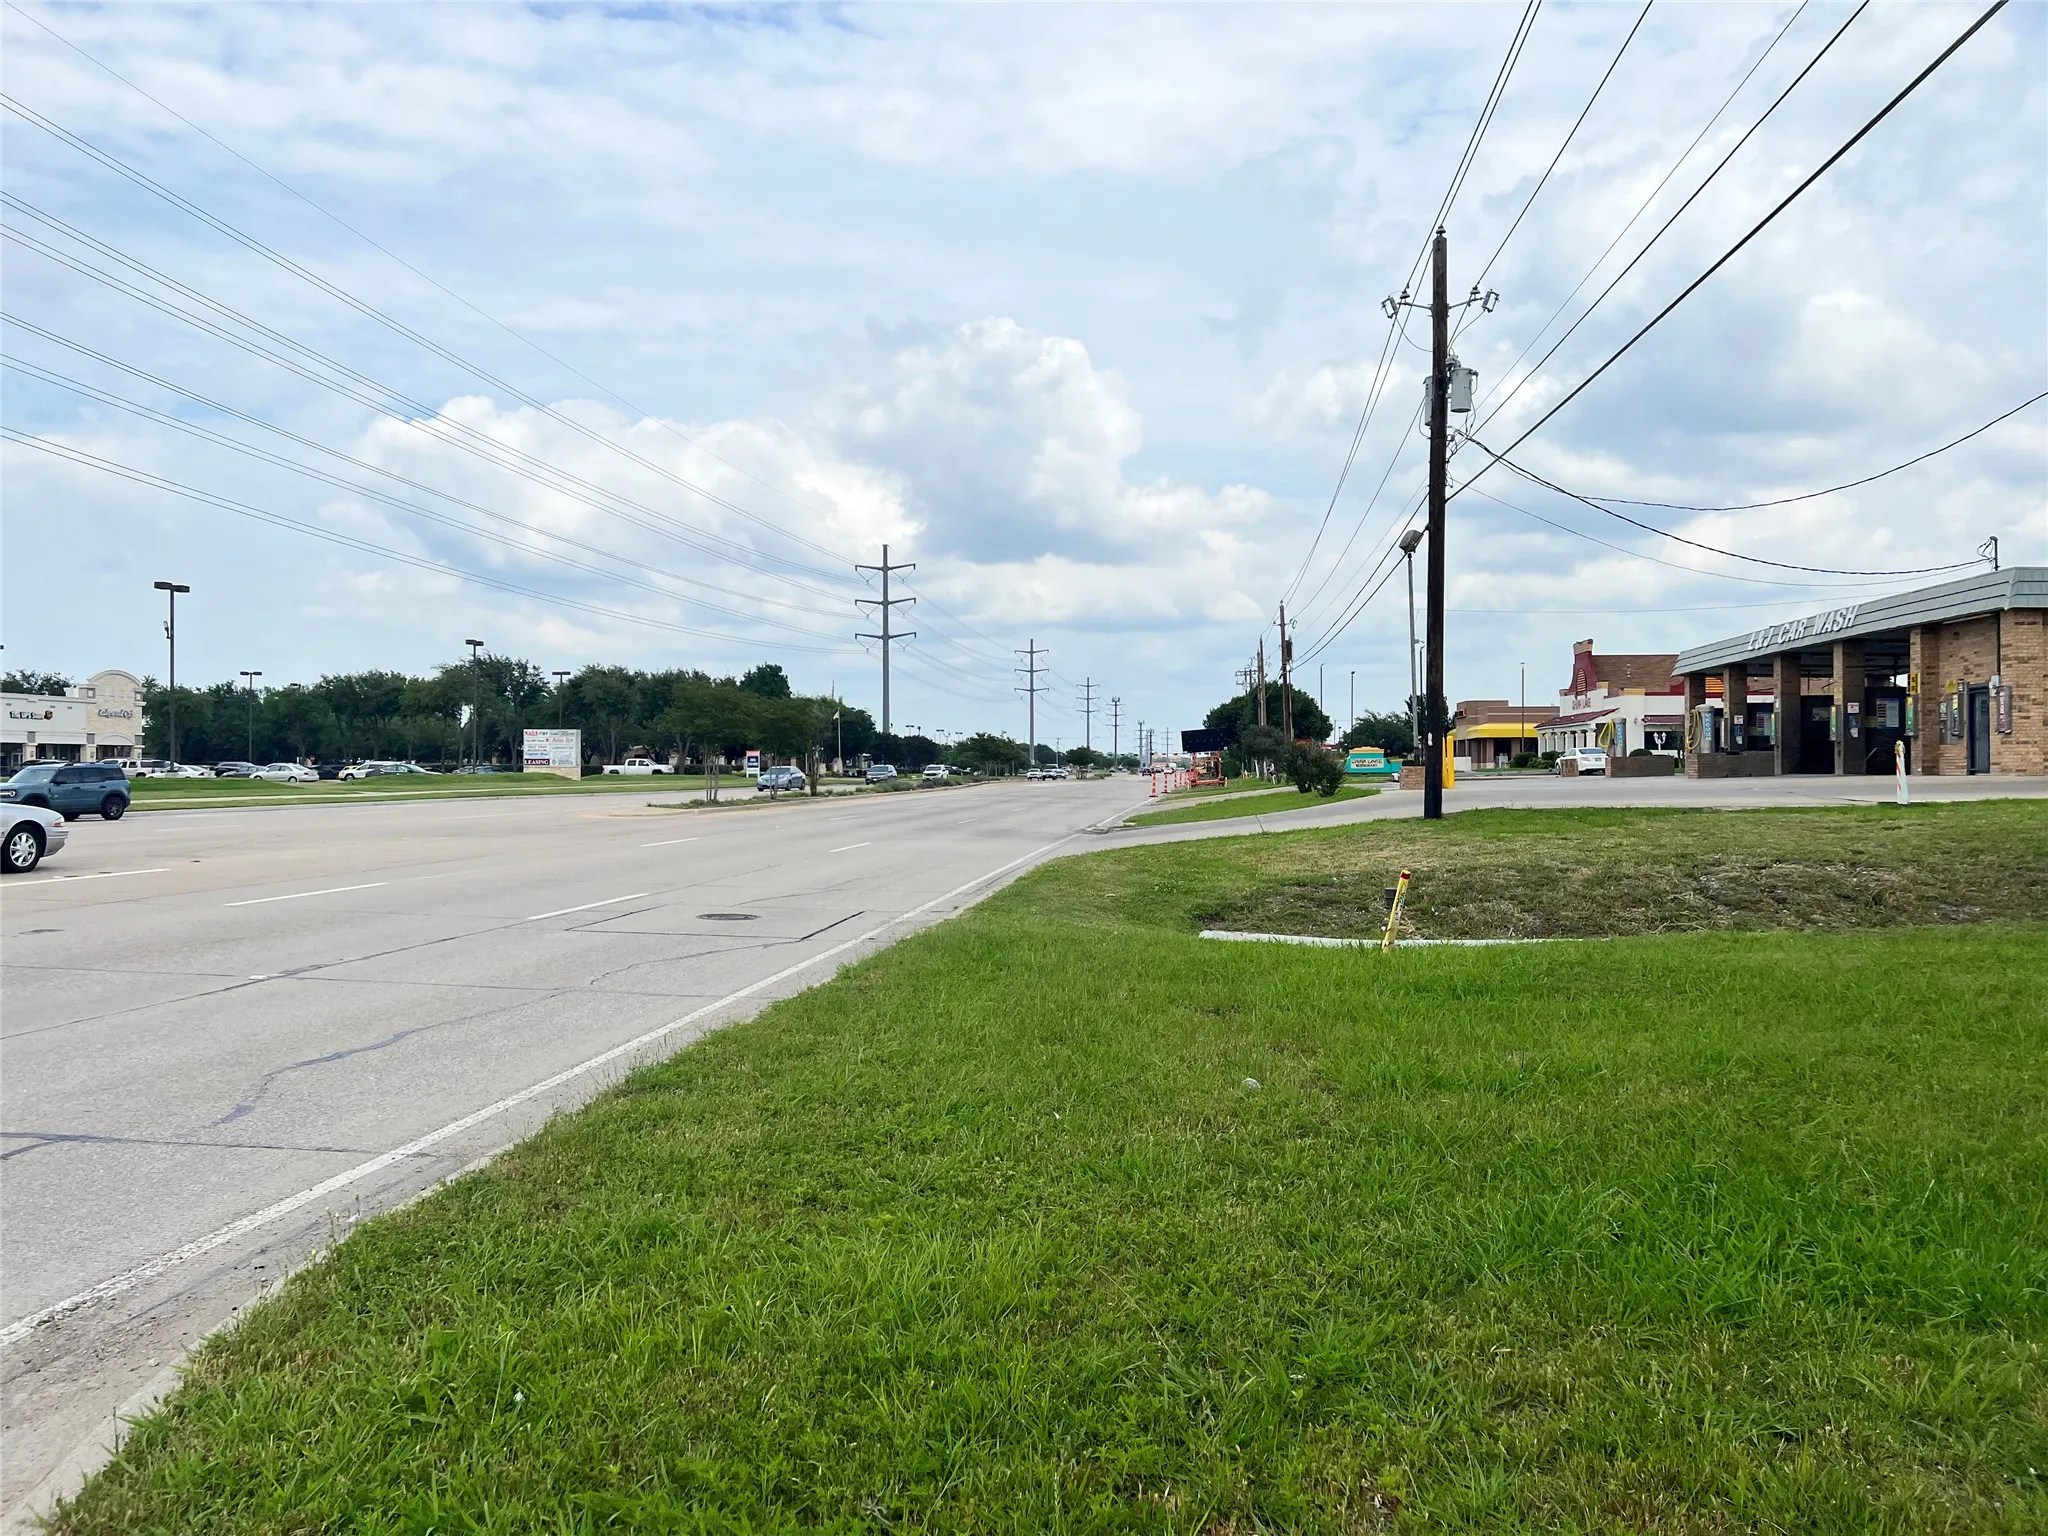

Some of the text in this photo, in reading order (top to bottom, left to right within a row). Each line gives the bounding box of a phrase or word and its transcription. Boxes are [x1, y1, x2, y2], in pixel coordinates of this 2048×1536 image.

[1747, 604, 1859, 651] L&J CAR WASH
